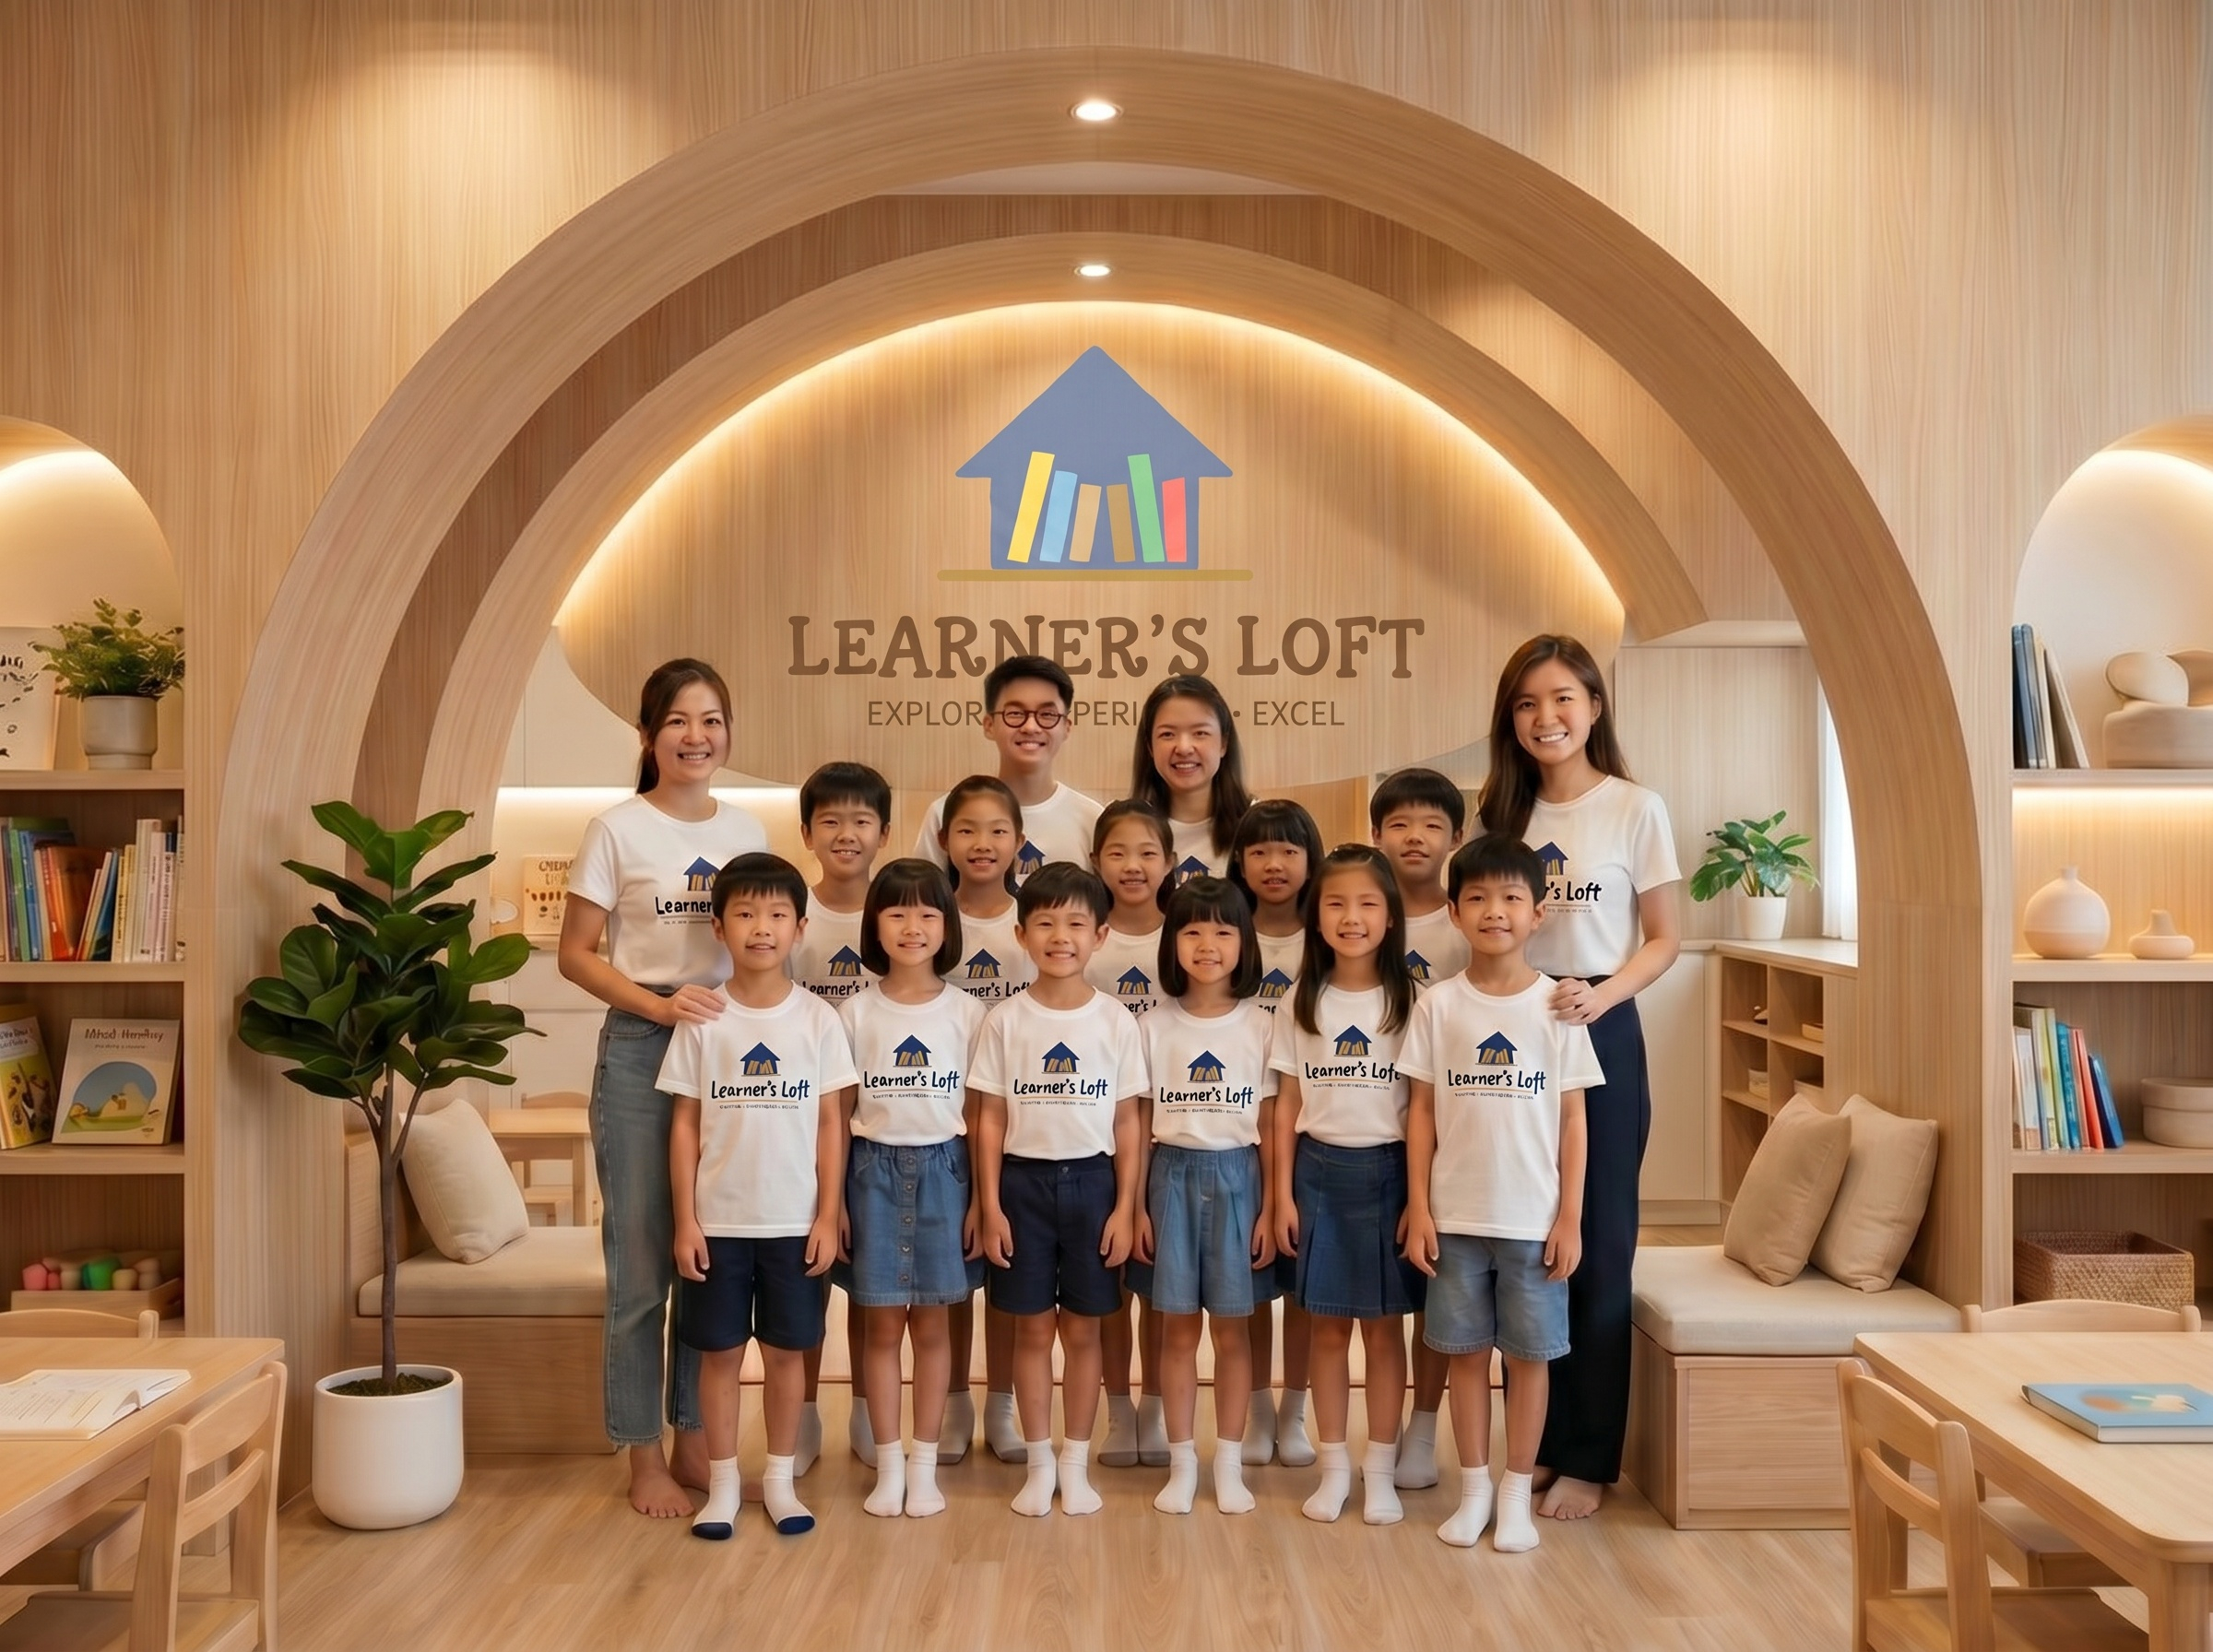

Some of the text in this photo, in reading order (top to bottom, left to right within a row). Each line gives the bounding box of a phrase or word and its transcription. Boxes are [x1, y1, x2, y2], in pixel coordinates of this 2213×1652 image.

[787, 614, 1425, 678] LEARNER'S LOFT
[868, 701, 1345, 726] EXPLOR EXCEL
[1566, 880, 1603, 902] Loft
[655, 896, 713, 915] Learner
[1305, 1060, 1367, 1080] Learner's
[711, 1079, 811, 1101] Learner's Loft
[864, 1070, 961, 1093] Learner's Loft
[1013, 1078, 1108, 1100] Learner's Loft
[1448, 1068, 1546, 1095] Learner's Loft
[1159, 1086, 1254, 1109] Learner's Loft
